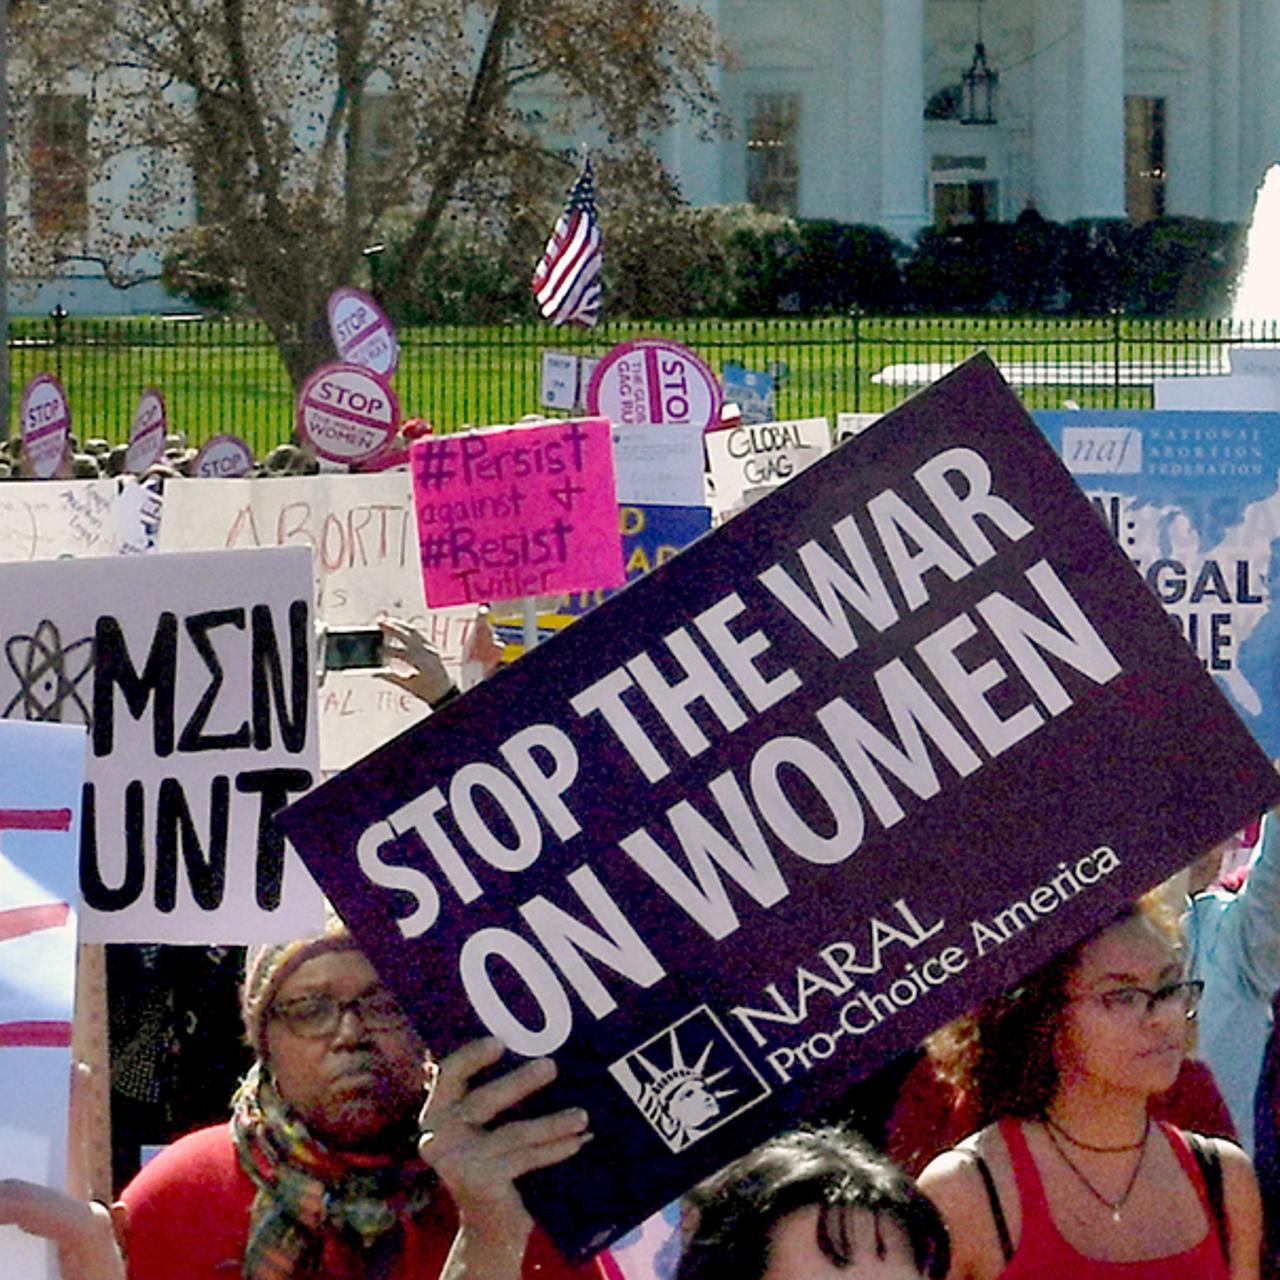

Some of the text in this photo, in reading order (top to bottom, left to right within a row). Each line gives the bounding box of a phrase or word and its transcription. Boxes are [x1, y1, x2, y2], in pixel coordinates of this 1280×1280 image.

[320, 381, 383, 414] STOP
[415, 423, 589, 490] #Persist
[727, 422, 813, 458] GLOBAL
[1072, 431, 1132, 472] naf
[1148, 445, 1263, 458] ABORTION
[1149, 429, 1262, 442] NATIONAL
[201, 453, 242, 477] STOP
[743, 454, 794, 484] GAG
[421, 487, 527, 531] against
[421, 518, 575, 569] #Resist
[1145, 559, 1263, 605] GAL
[356, 443, 1034, 940] STOP THE WAR
[458, 568, 1122, 1058] ON WOMEN
[730, 898, 945, 1049] NARAL
[765, 845, 1122, 1085] Pro-Choice America
